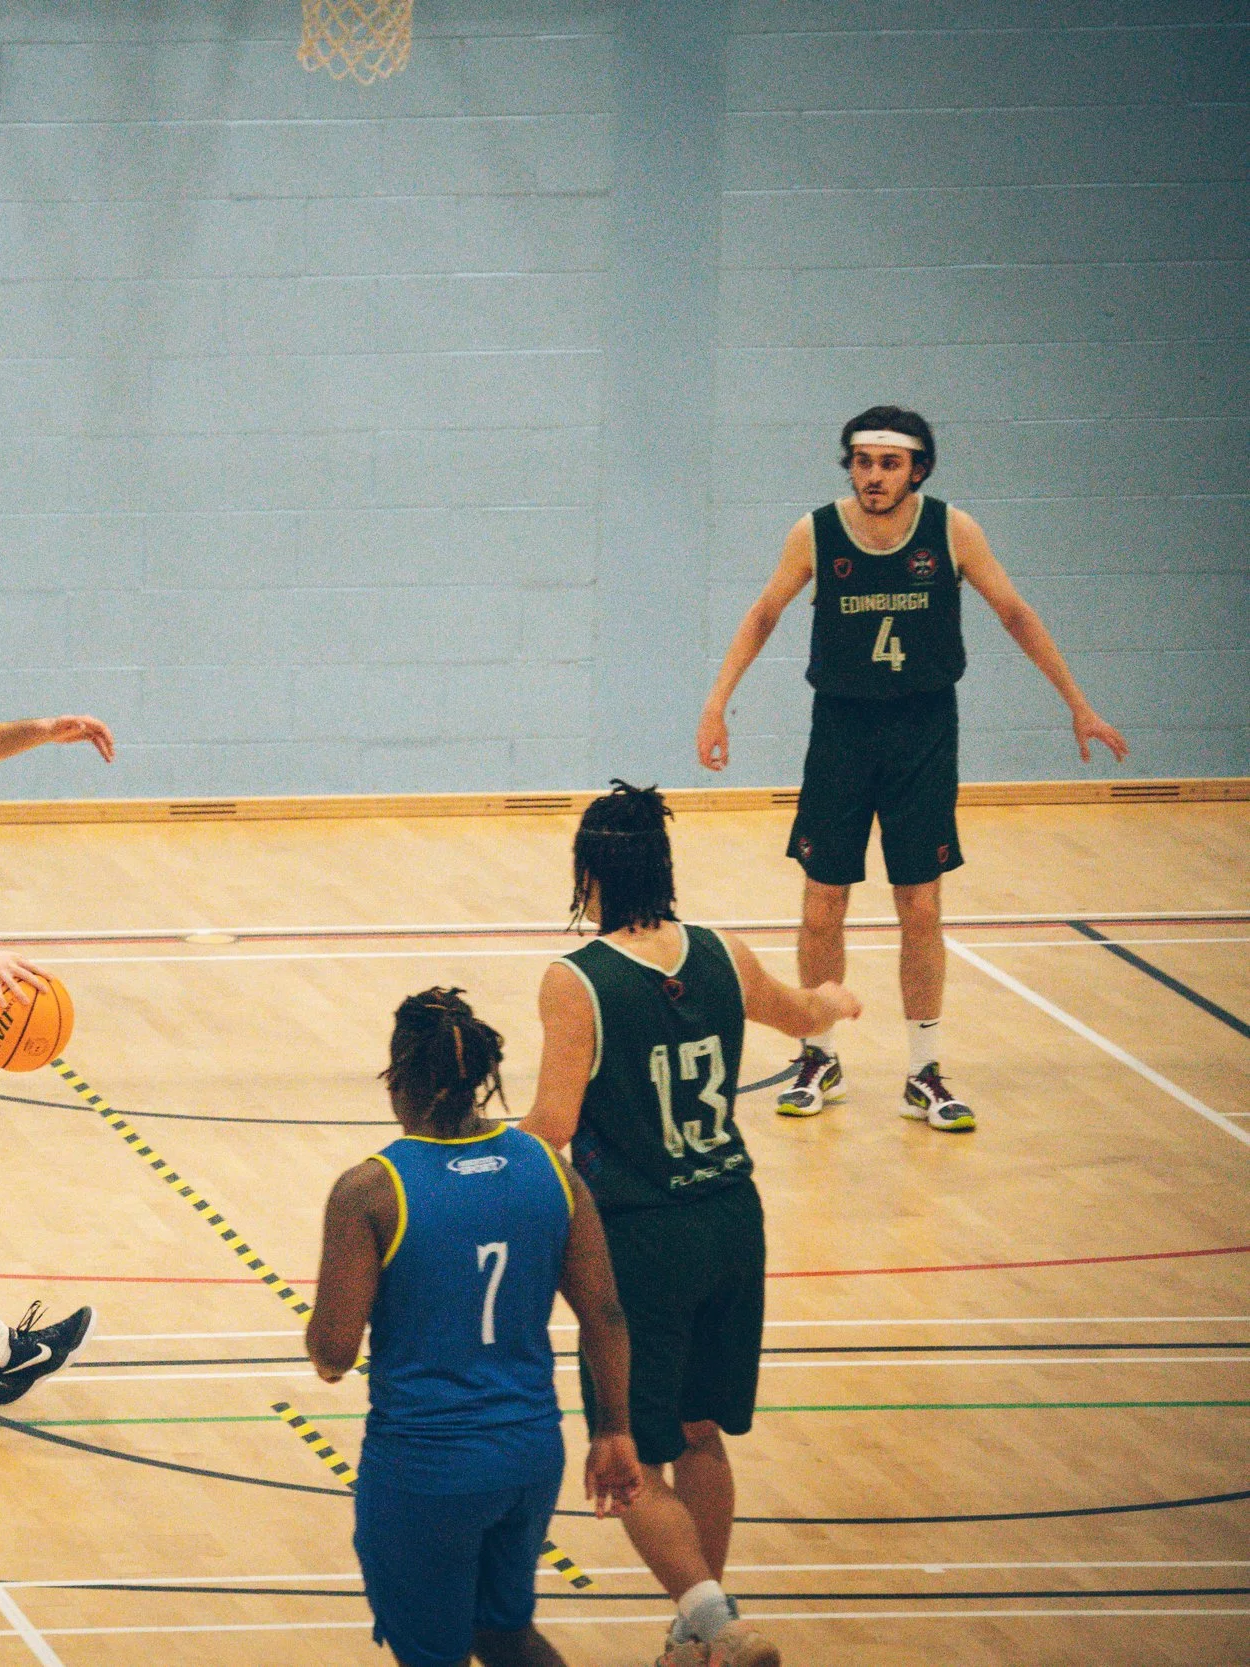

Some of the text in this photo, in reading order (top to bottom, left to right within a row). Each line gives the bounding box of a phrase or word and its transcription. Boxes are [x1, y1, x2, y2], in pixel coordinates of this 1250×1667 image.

[840, 591, 930, 614] EDINBURGH
[871, 616, 906, 672] 4
[650, 1034, 732, 1159] 13
[476, 1241, 509, 1345] 7
